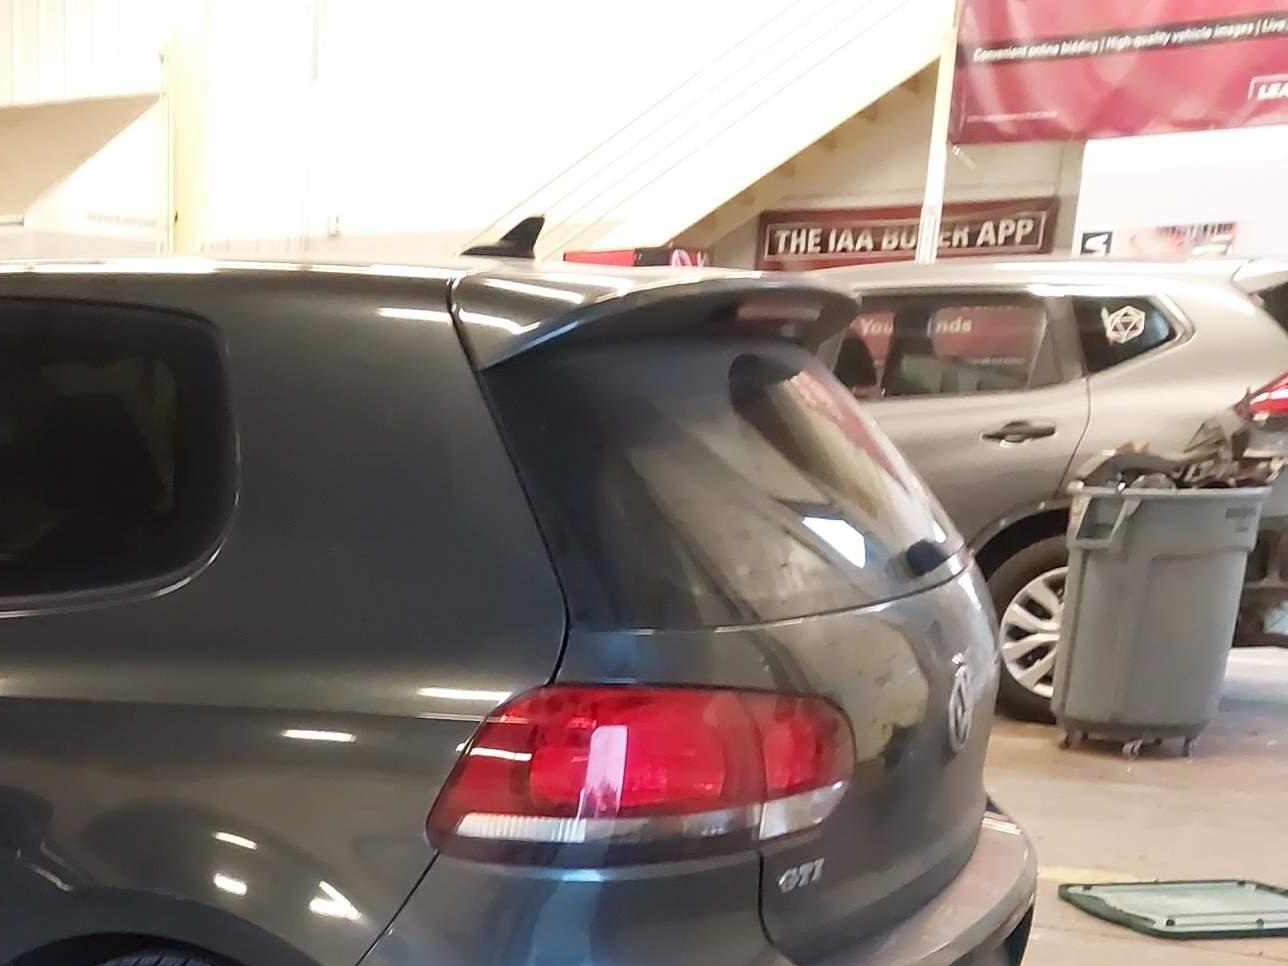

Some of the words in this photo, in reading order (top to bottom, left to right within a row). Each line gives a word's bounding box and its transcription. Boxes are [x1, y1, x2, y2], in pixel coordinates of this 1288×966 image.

[973, 45, 1028, 62] Convenient
[1060, 39, 1098, 55] bidding
[1212, 21, 1253, 38] images
[775, 228, 823, 255] THE
[828, 227, 874, 252] IAA
[882, 225, 969, 251] BUER
[975, 218, 1035, 248] APP
[861, 318, 894, 337] You
[935, 316, 973, 335] nds
[778, 857, 825, 894] GTI
